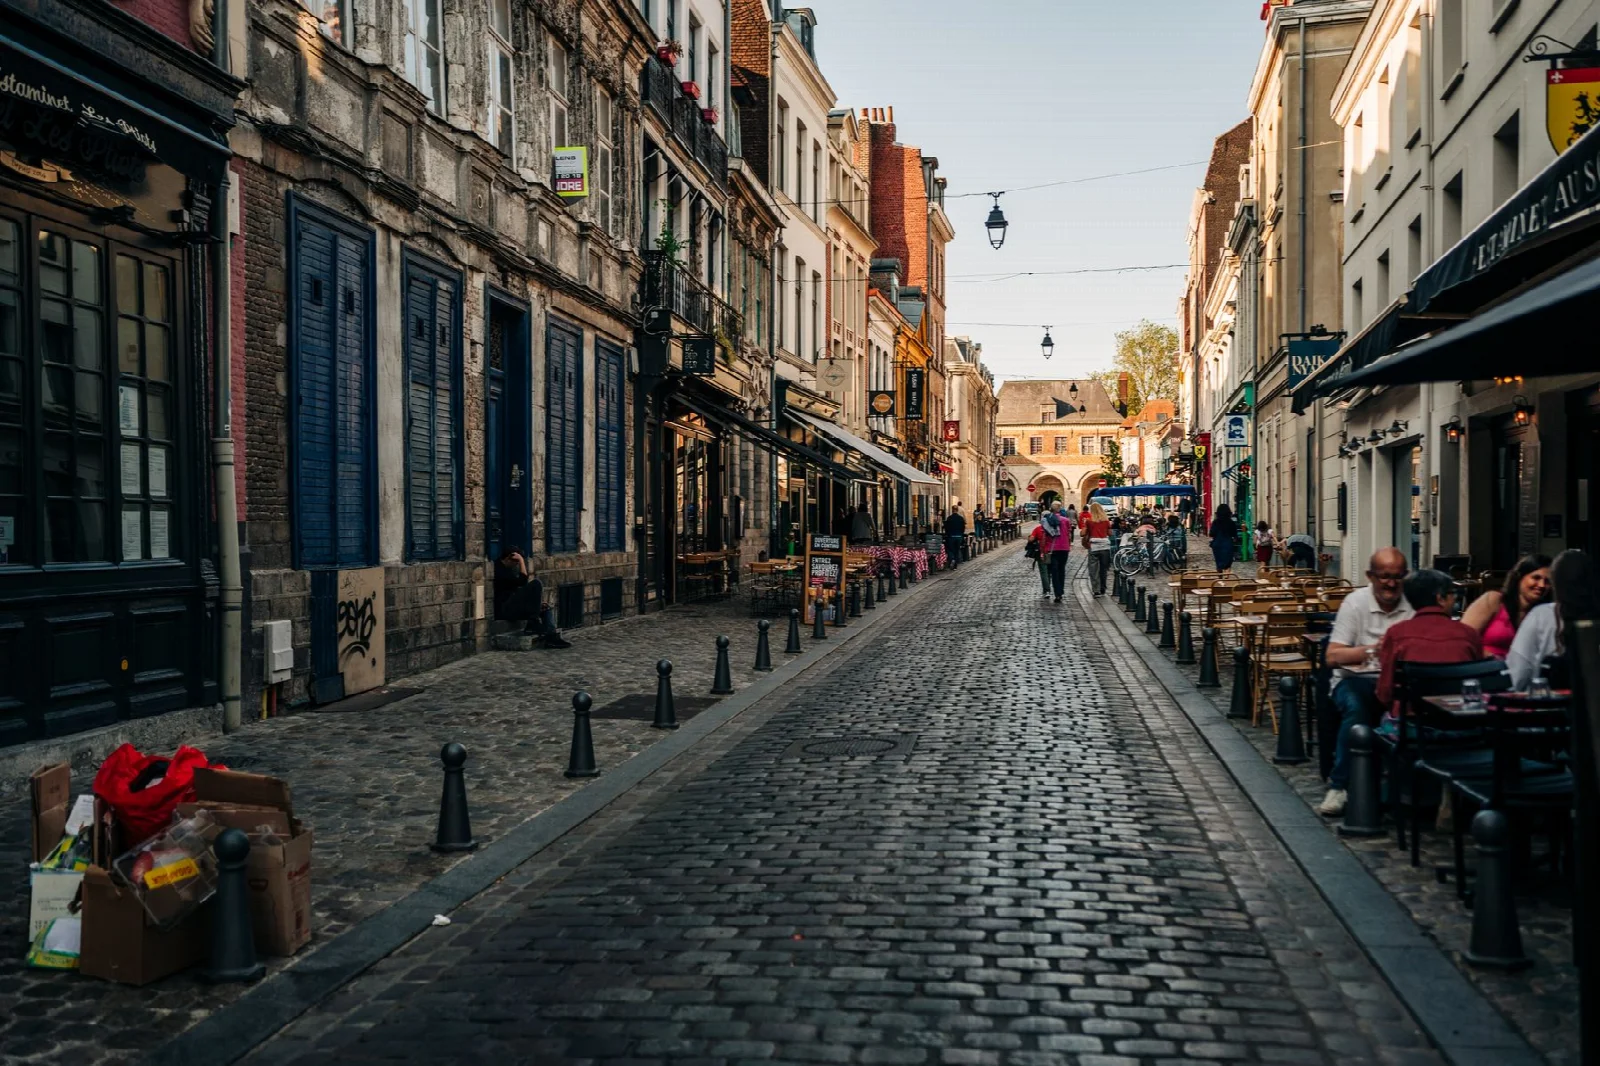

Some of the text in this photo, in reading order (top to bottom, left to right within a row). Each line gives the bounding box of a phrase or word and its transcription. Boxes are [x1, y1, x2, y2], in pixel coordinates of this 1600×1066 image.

[0, 66, 74, 113] staminet
[1554, 170, 1581, 213] AU
[1291, 355, 1333, 366] DAIK
